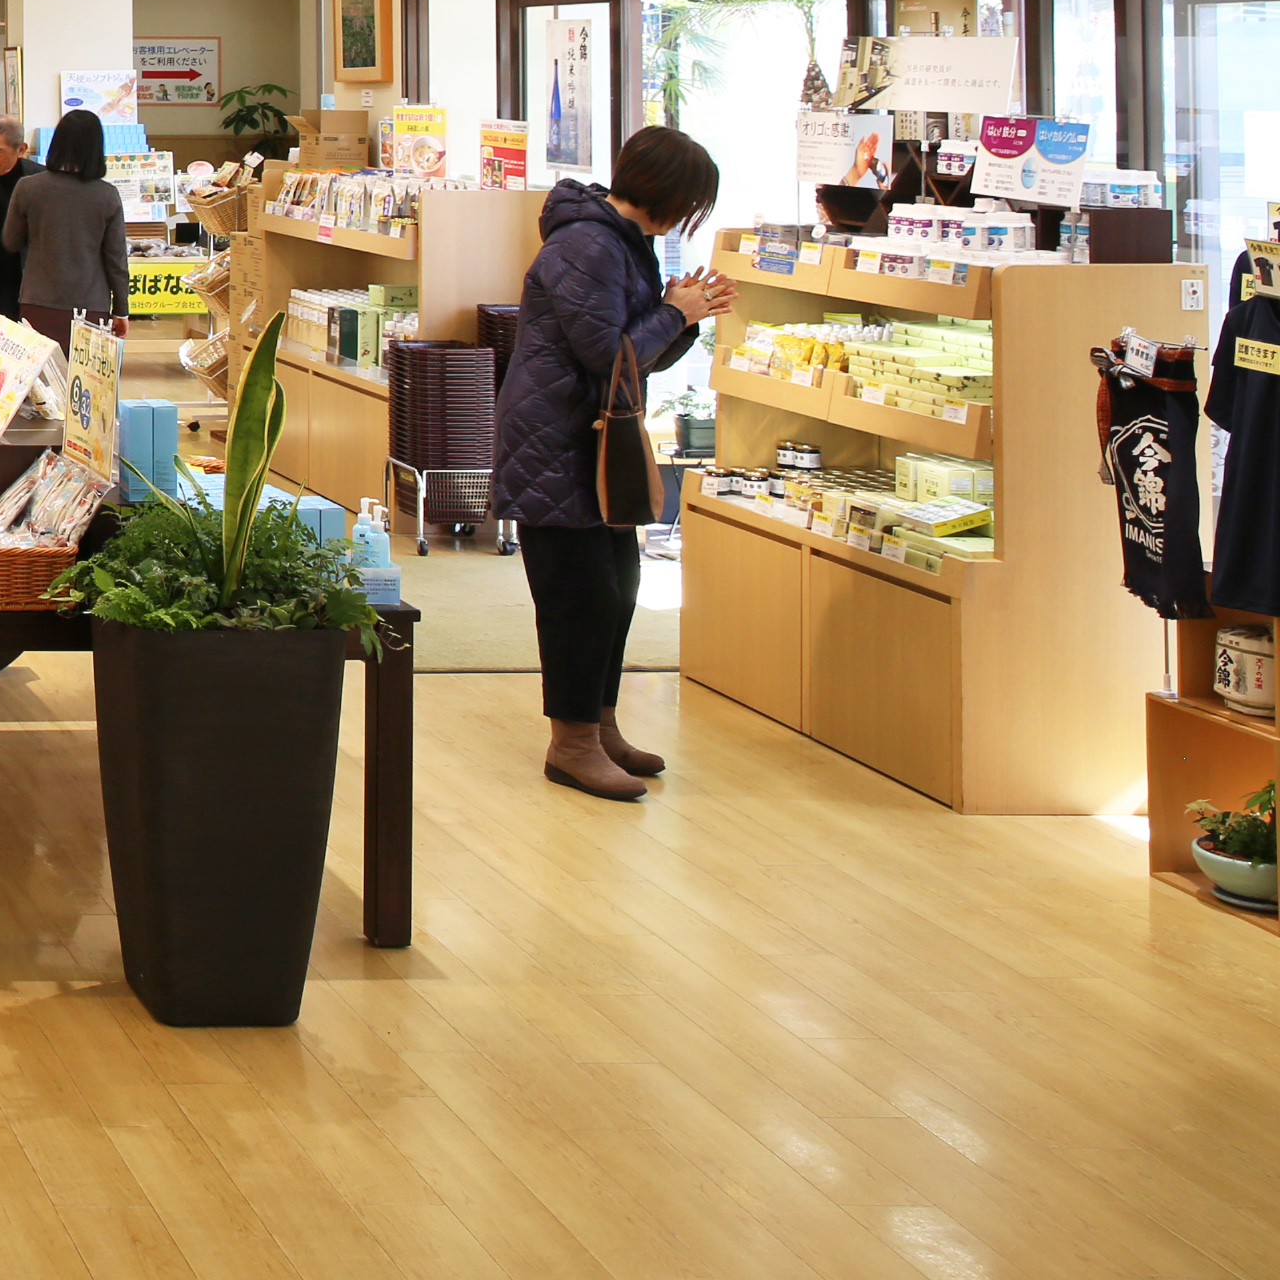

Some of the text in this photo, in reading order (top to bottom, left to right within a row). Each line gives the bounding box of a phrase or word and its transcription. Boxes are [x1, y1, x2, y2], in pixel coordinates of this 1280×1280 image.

[140, 57, 207, 67] をご利用ください
[1237, 342, 1277, 361] 試着できます
[1132, 431, 1172, 515] 今錦
[1217, 648, 1234, 689] 今錦
